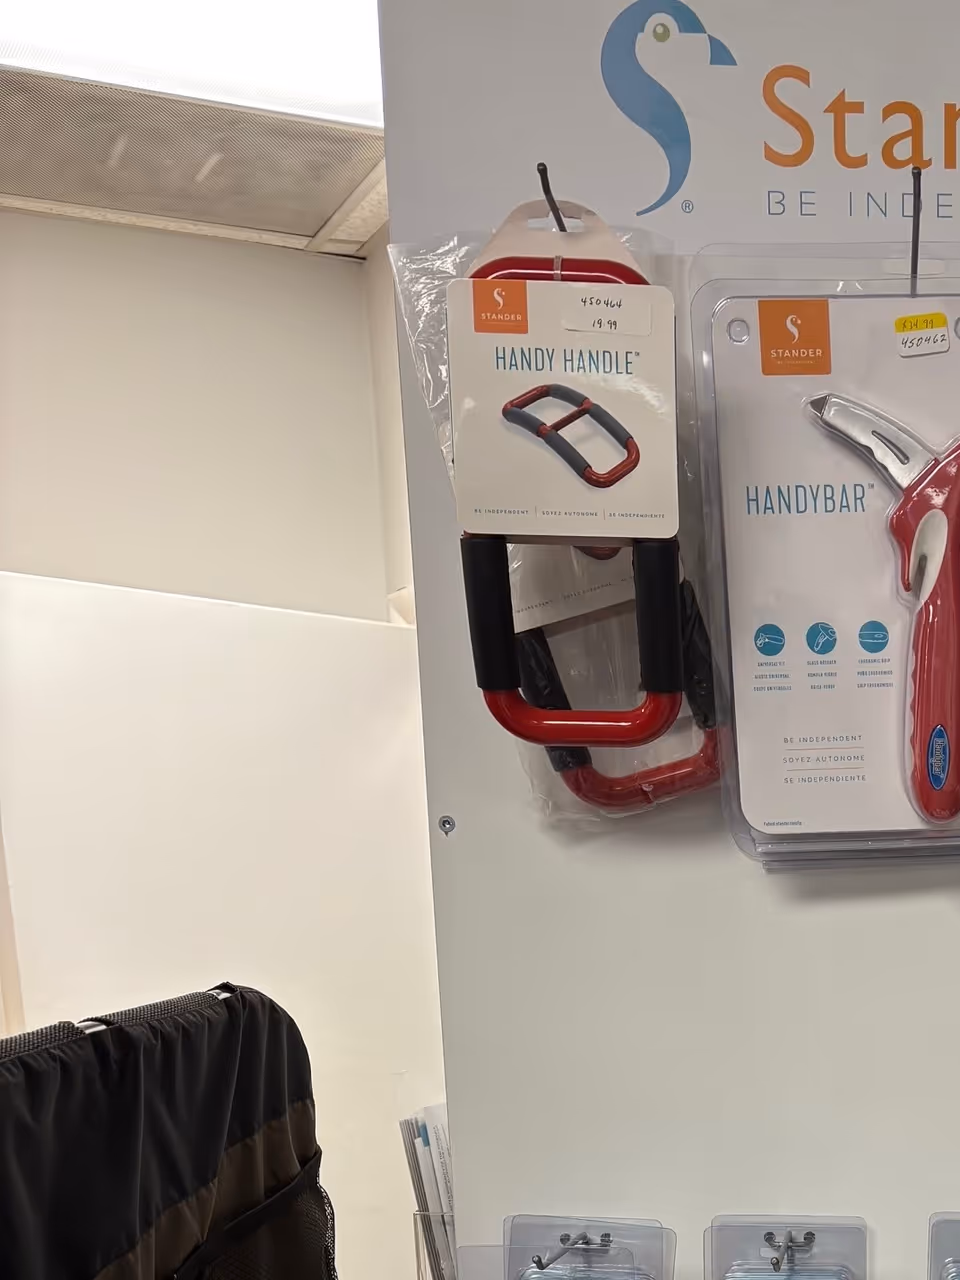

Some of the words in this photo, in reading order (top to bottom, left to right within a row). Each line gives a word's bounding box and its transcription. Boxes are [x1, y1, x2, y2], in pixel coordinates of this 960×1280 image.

[766, 190, 816, 217] BE
[581, 296, 622, 309] 450464
[481, 312, 522, 321] STANDER
[901, 334, 947, 349] 450462
[771, 349, 823, 358] STANDER
[495, 346, 555, 371] HANDY
[799, 735, 863, 743] INDEPENDENT
[783, 756, 811, 764] SOYEZ
[815, 755, 865, 763] AUTONOME
[798, 775, 866, 783] INDEPENDIENTE
